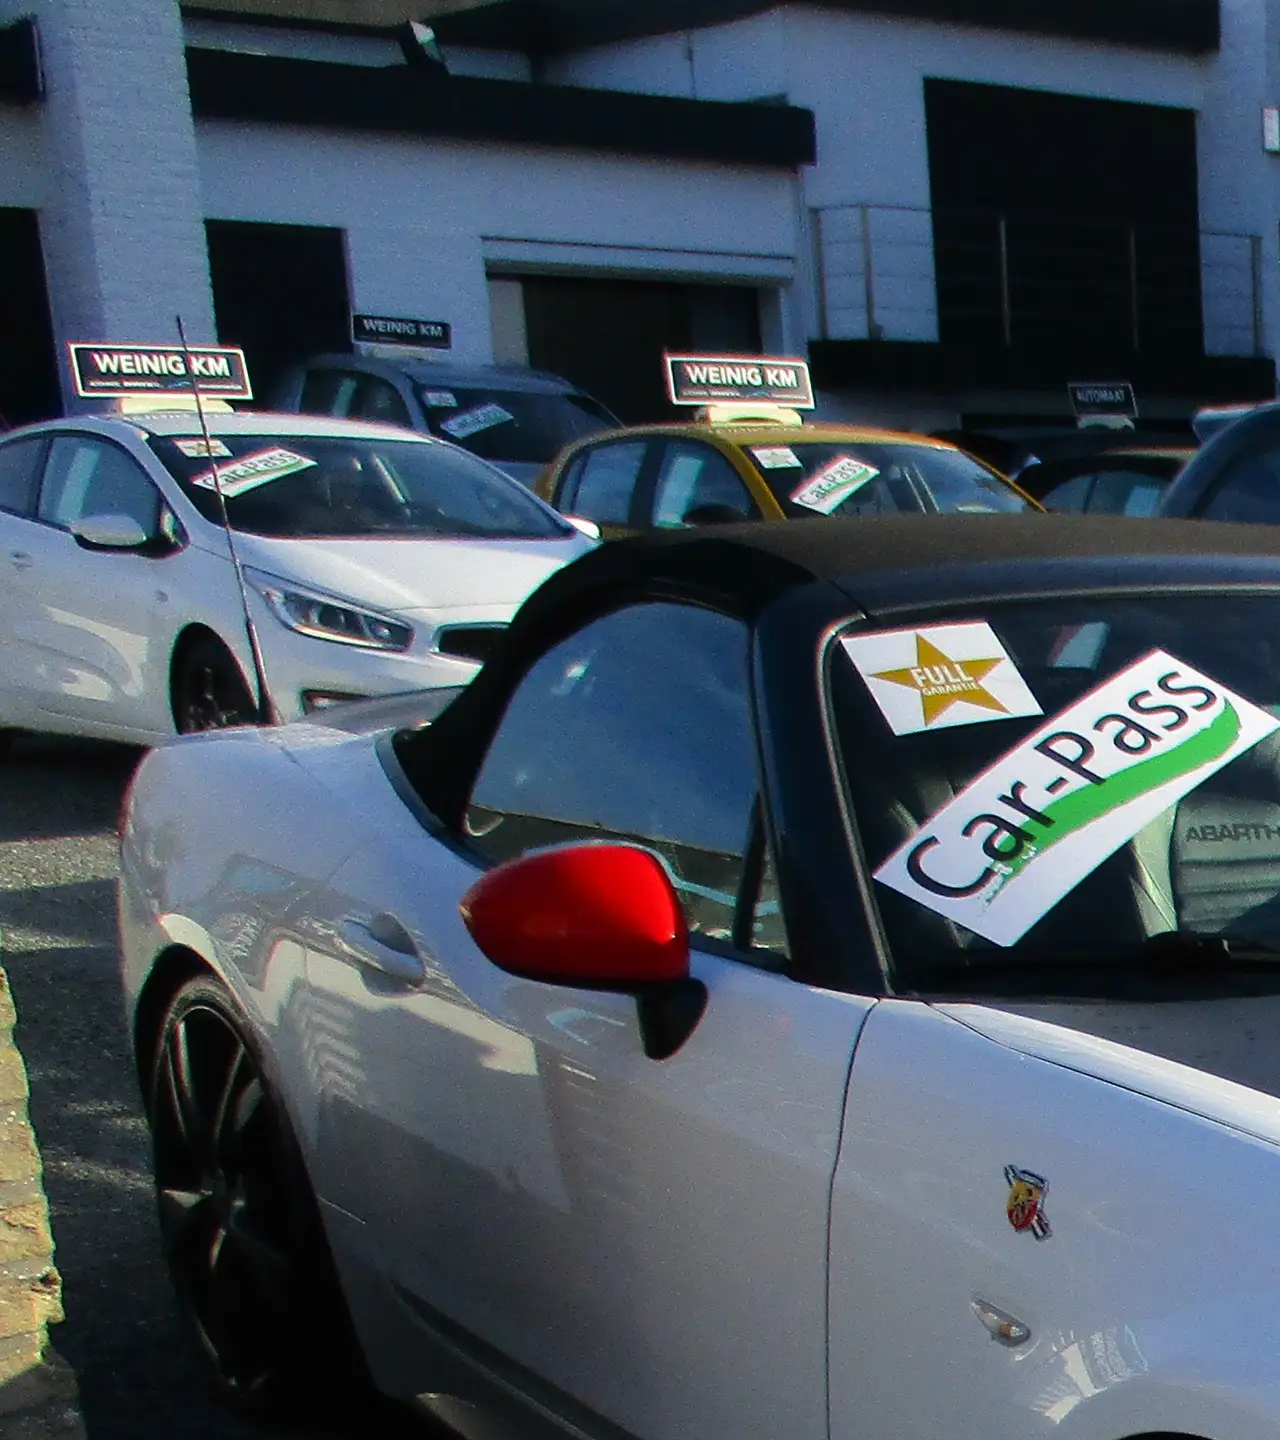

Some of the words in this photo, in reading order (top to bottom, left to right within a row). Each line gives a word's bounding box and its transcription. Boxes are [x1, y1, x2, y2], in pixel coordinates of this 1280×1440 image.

[362, 318, 417, 335] WEINIG
[420, 325, 444, 337] KM
[93, 352, 186, 376] WEINIG
[190, 355, 231, 377] KM
[685, 364, 762, 386] WEINIG
[765, 367, 798, 388] KM
[799, 462, 864, 505] Car-Pass
[910, 663, 974, 688] FULL
[922, 680, 981, 697] GARANTIE
[906, 670, 1217, 899] Car-Pass
